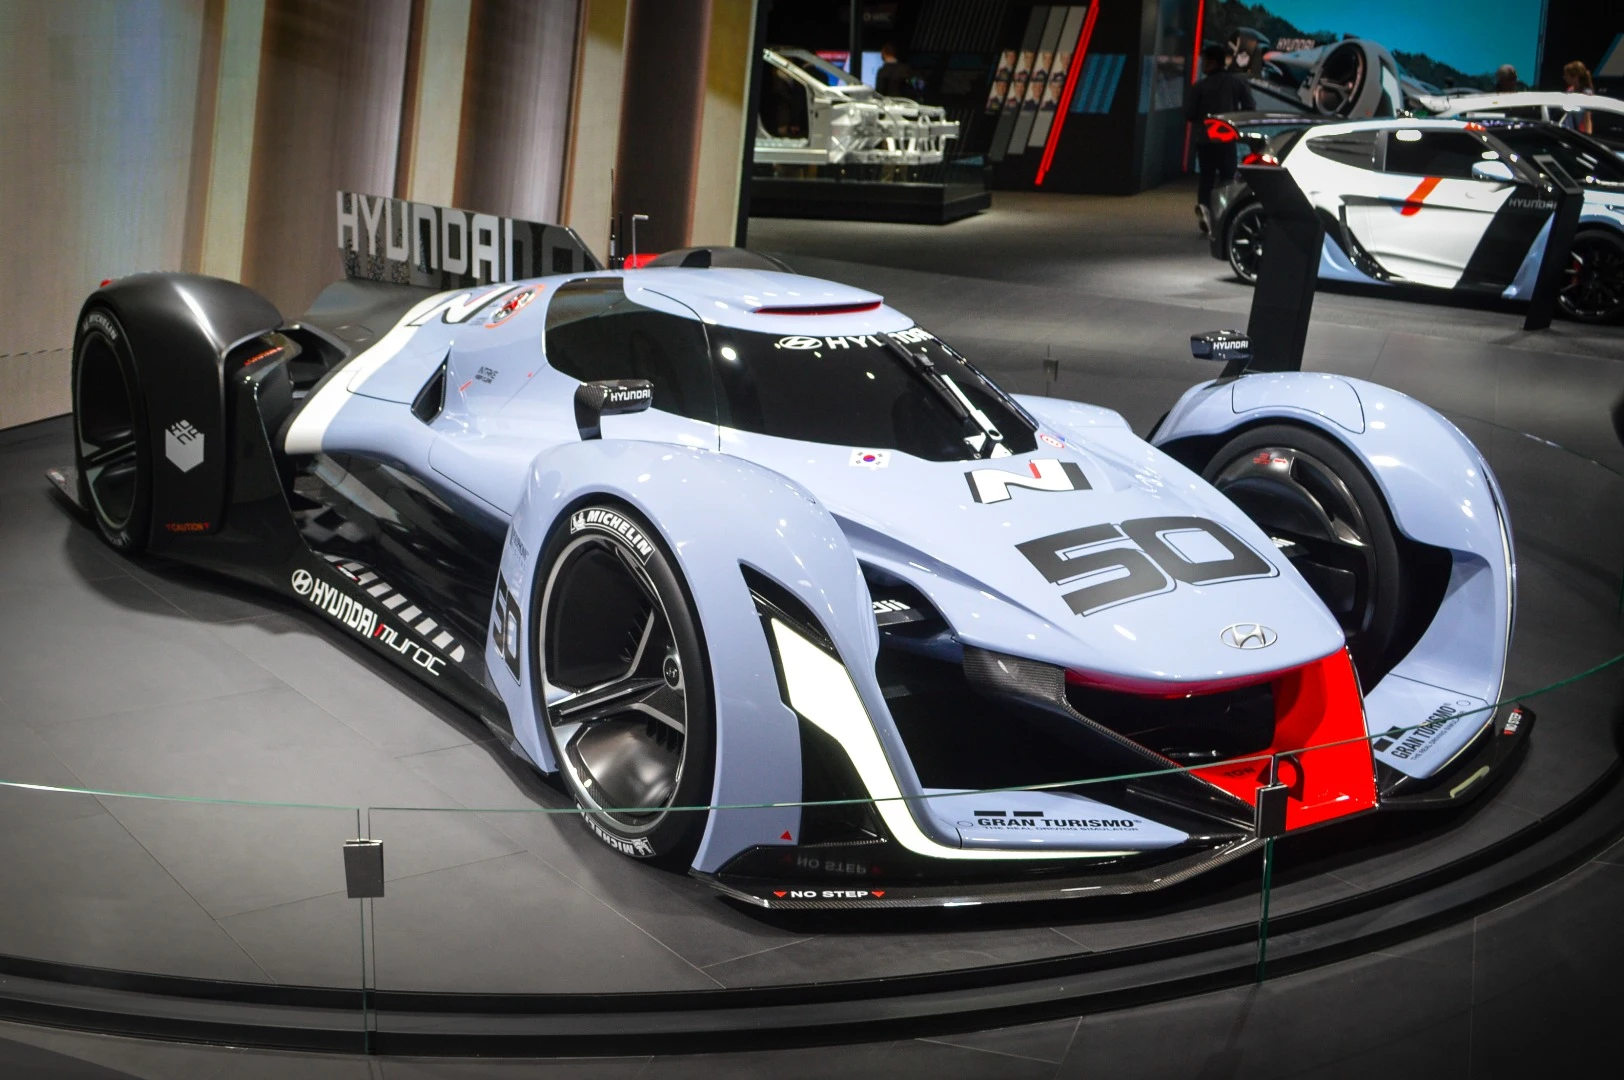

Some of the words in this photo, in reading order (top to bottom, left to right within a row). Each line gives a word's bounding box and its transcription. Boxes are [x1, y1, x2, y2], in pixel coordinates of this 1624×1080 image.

[1508, 198, 1557, 210] HYUNDAI
[337, 191, 513, 284] HYUNDAI
[89, 313, 118, 340] MICHELIN
[1213, 340, 1249, 350] HYUNDAI
[610, 389, 651, 402] HYUNDAI
[172, 523, 204, 532] CAUTION
[587, 509, 654, 557] MICHELIN
[1014, 516, 1280, 618] 50
[309, 577, 378, 638] HYUNDAI
[1391, 736, 1425, 760] GRAN
[576, 803, 636, 855] MICHELIN
[977, 818, 1035, 828] GRAN
[790, 890, 817, 898] NO
[822, 890, 869, 898] STEP
